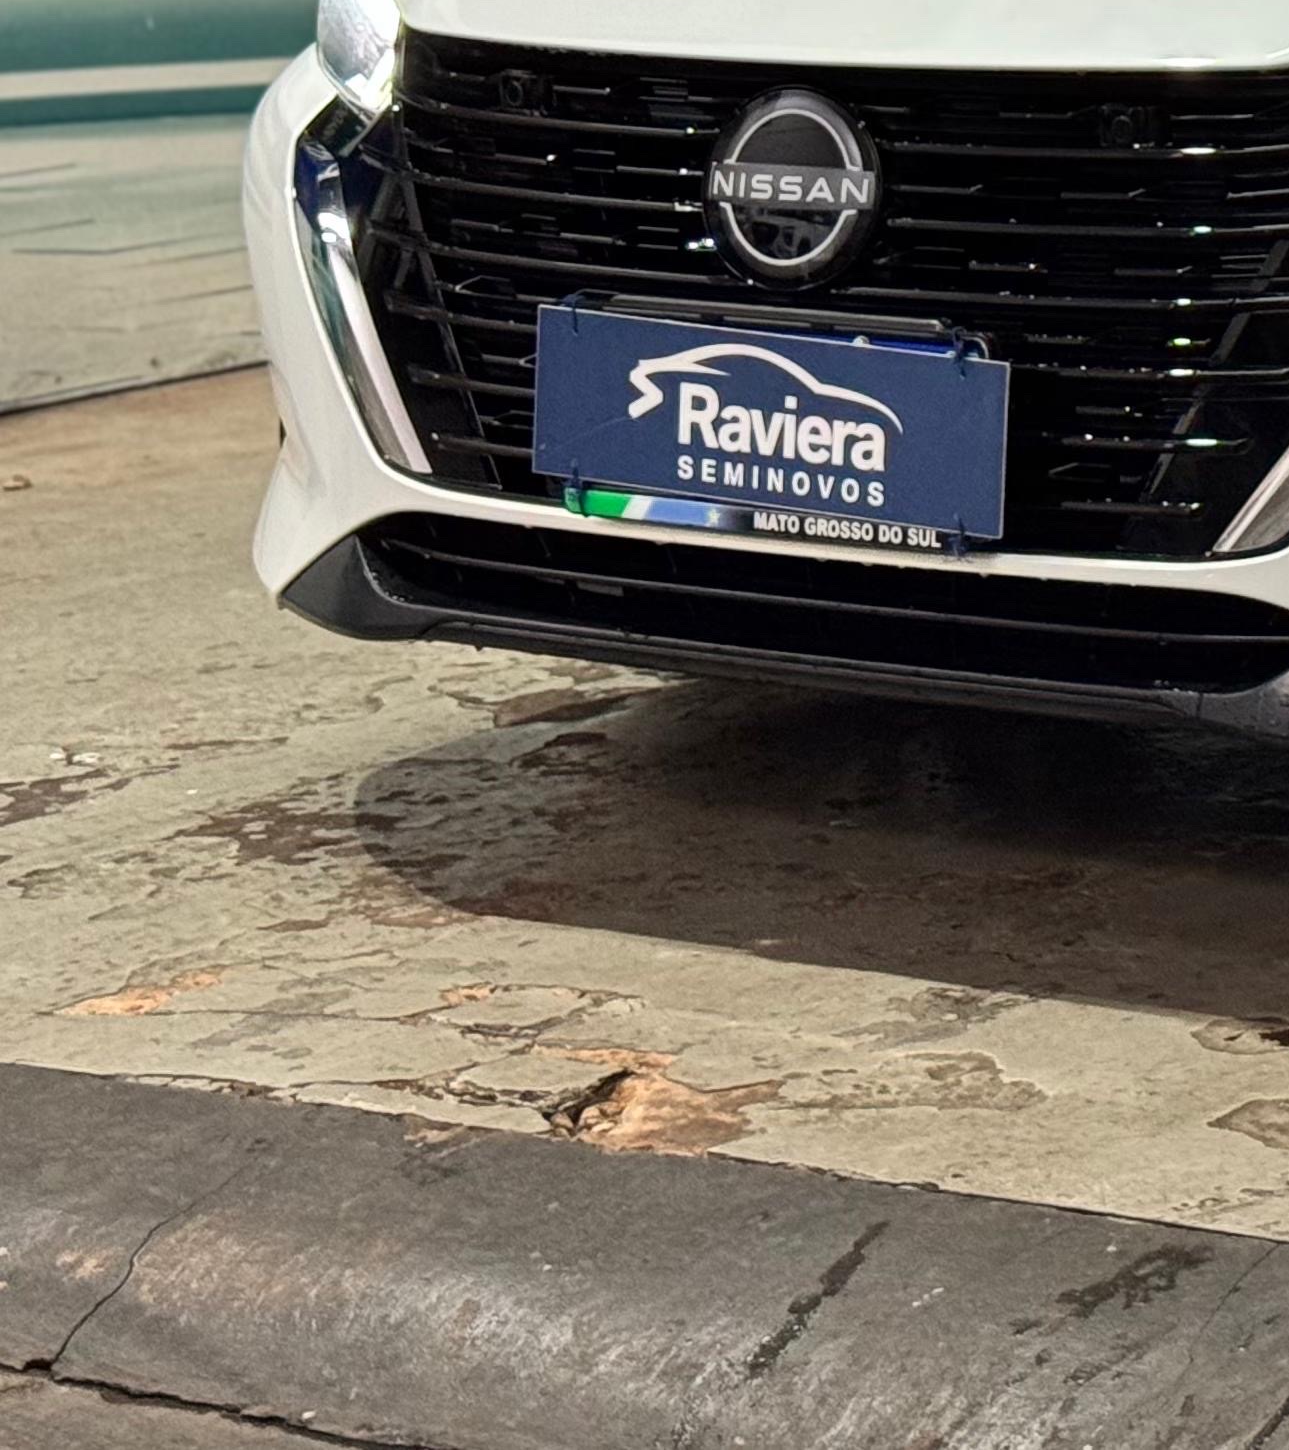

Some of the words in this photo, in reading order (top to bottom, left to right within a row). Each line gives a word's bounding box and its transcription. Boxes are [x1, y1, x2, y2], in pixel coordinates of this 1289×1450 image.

[711, 169, 870, 204] NISSAN
[677, 381, 887, 473] Raviera
[676, 454, 886, 507] SEMINOVOS
[753, 511, 800, 534] MATO
[804, 516, 875, 542] GROSSO
[878, 524, 903, 544] DO
[907, 527, 942, 548] SUL
